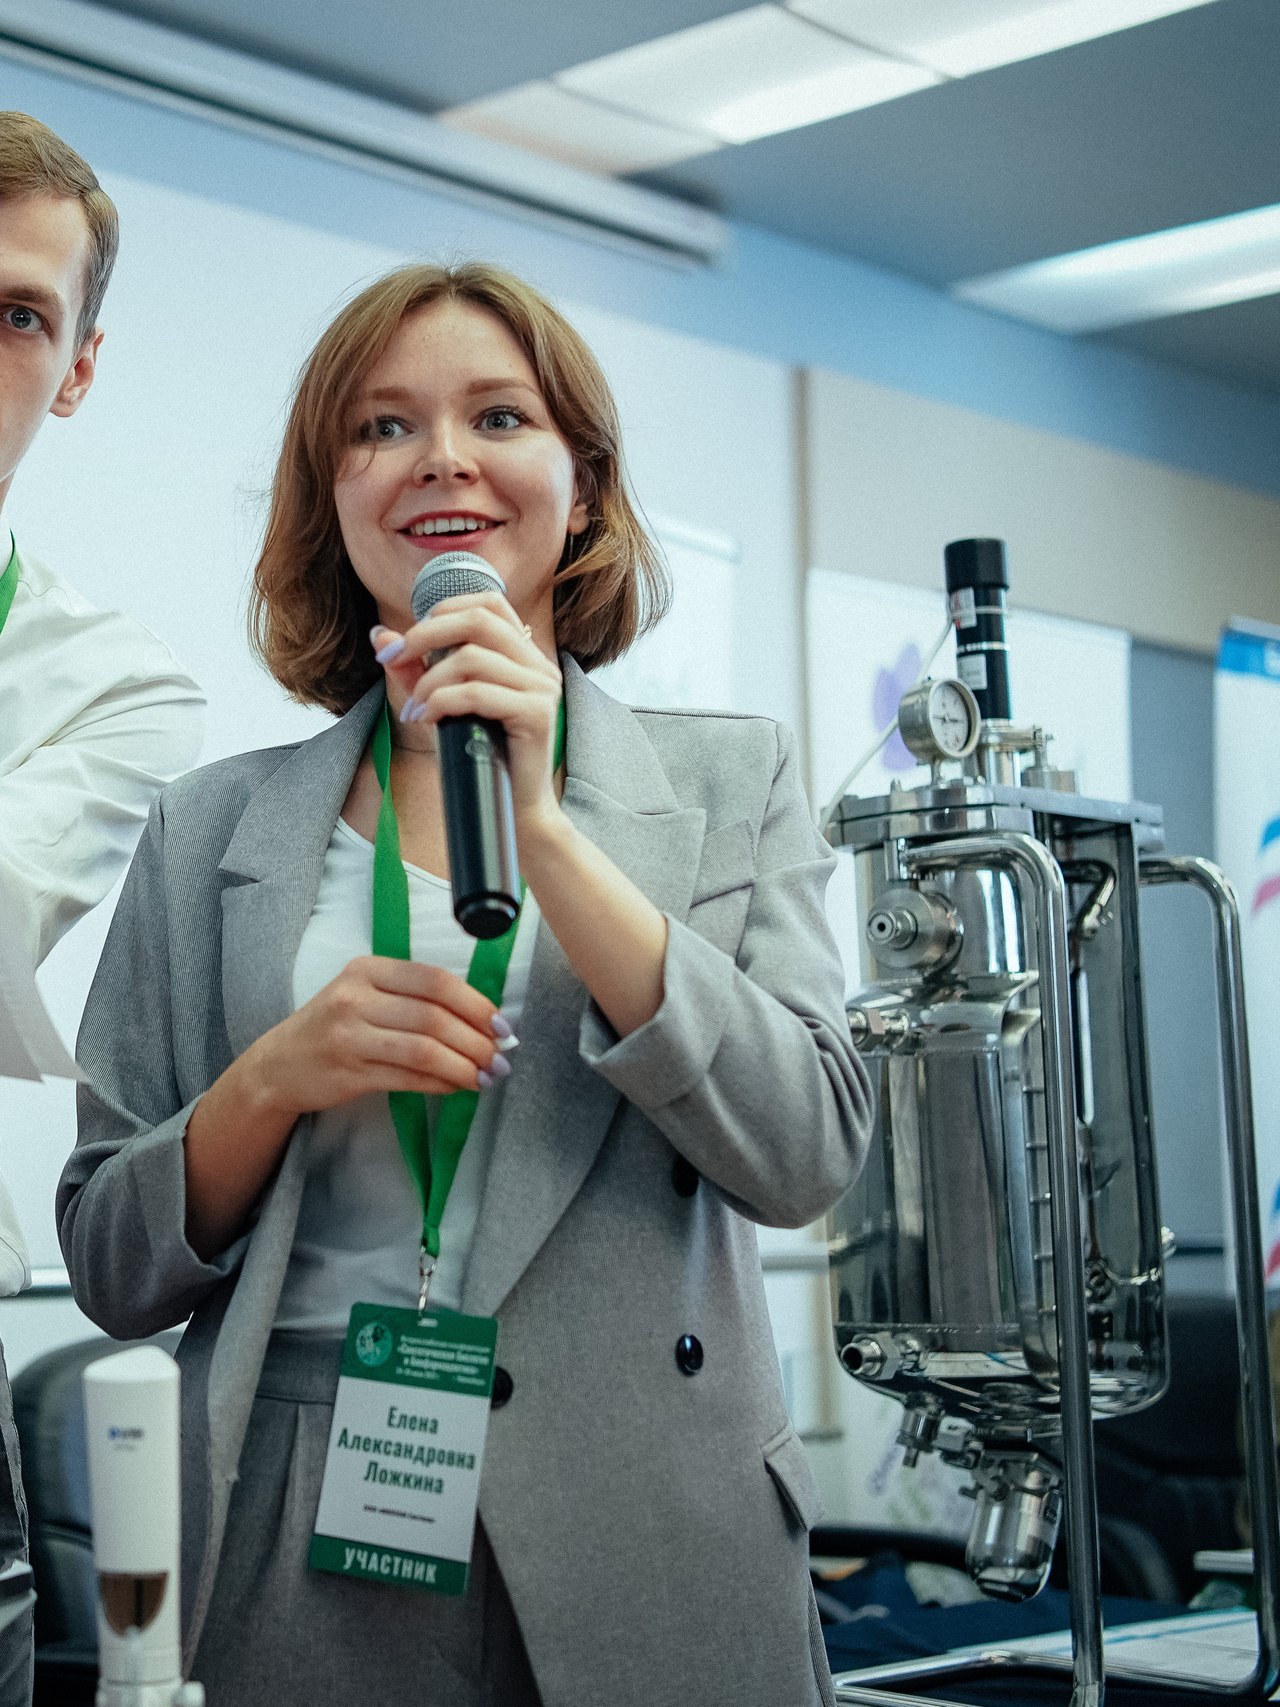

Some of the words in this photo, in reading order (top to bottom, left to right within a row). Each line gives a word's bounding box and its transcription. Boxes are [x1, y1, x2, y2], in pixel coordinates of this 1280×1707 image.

[386, 1405, 440, 1436] Елена
[337, 1427, 477, 1471] Александровна
[363, 1459, 445, 1495] Ложкина
[342, 1546, 439, 1585] УЧАСТНИК
